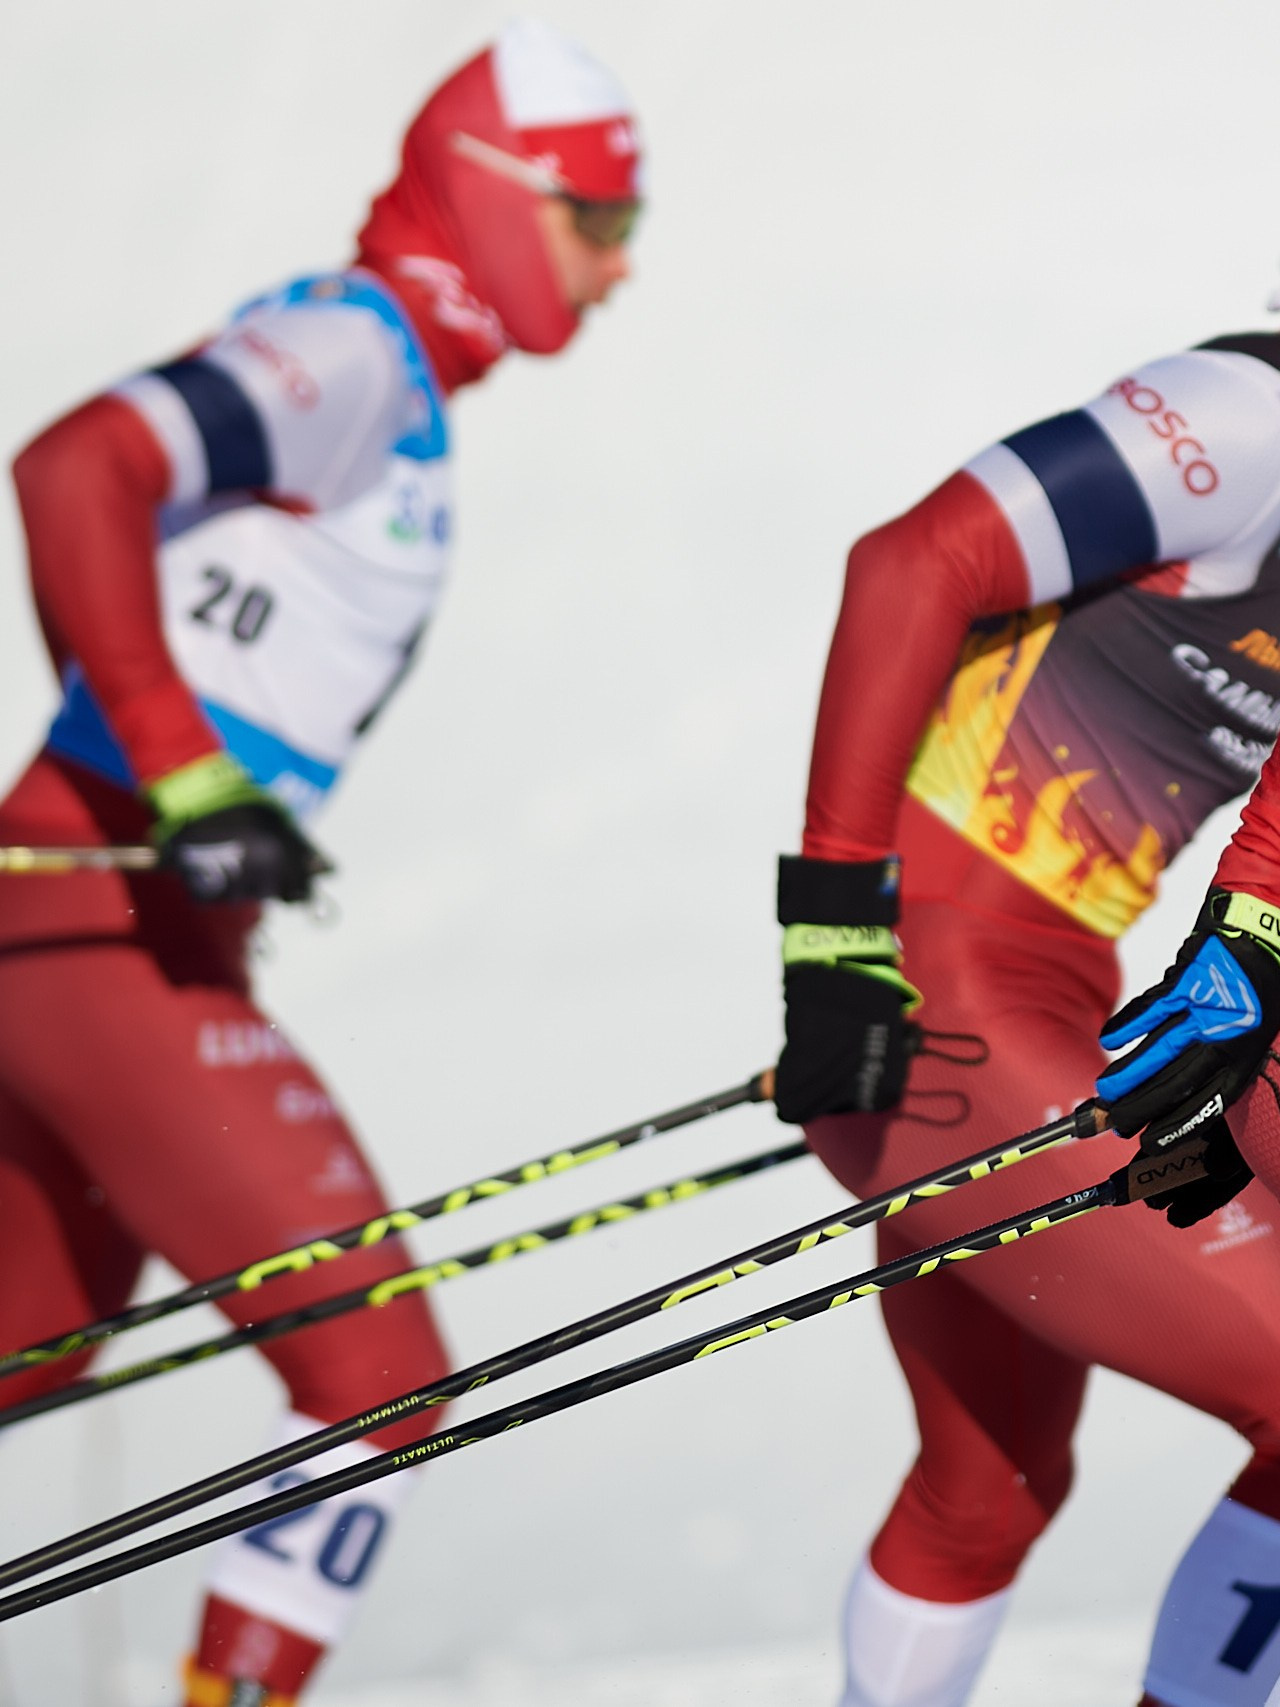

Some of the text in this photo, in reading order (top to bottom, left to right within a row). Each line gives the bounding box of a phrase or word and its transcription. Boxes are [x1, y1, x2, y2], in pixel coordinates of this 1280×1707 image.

[189, 565, 277, 645] 20
[357, 1395, 419, 1428] ULTIMATE
[393, 1435, 455, 1467] ULTIMATE
[243, 1469, 389, 1588] 20
